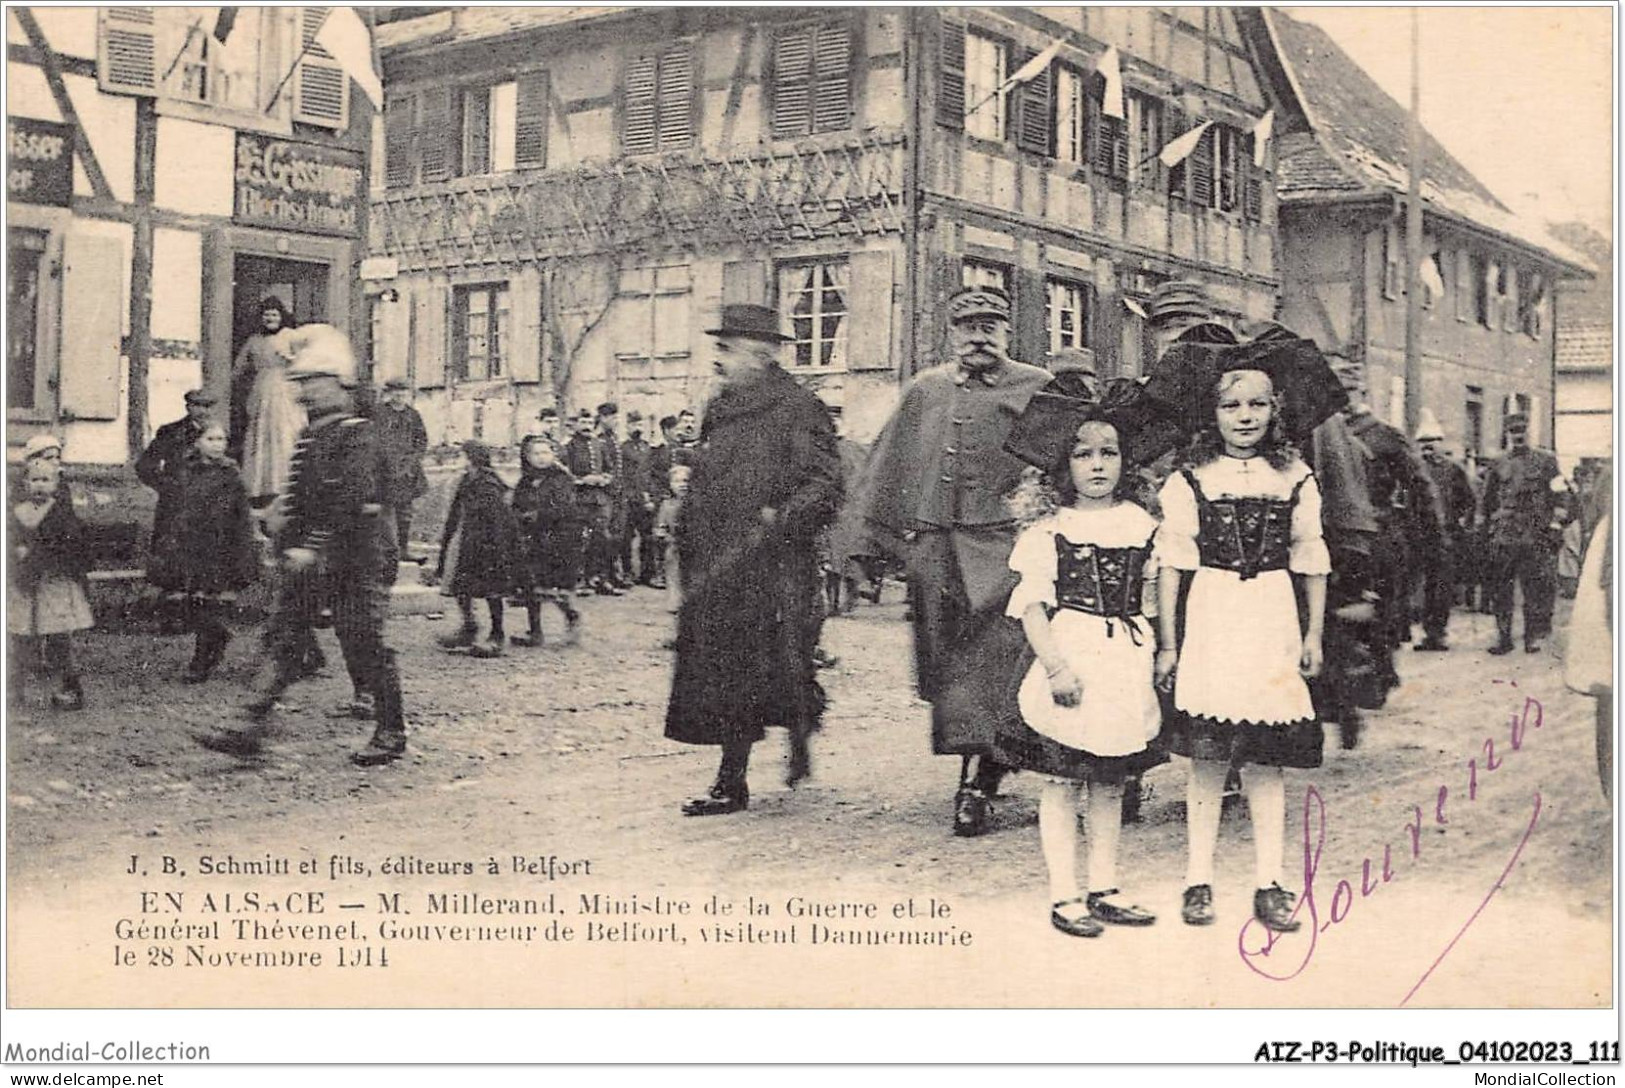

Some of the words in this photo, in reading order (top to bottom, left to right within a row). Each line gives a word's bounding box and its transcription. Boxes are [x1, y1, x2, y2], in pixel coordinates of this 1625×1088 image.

[126, 855, 148, 877] J.
[162, 855, 187, 878] B.
[199, 854, 289, 876] Schmitt
[299, 858, 317, 875] et
[330, 854, 373, 880] fils,
[381, 856, 474, 875] éditeurs
[488, 857, 500, 875] à
[513, 855, 591, 881] Belfort
[140, 891, 184, 913] EN
[200, 891, 326, 914] ALSACE
[377, 891, 411, 914] M.
[578, 893, 692, 916] Ministre
[703, 895, 734, 916] de
[748, 896, 771, 916] la
[786, 897, 878, 918] Guerre
[892, 898, 915, 919] et
[930, 898, 952, 919] le
[114, 918, 219, 940] Général
[378, 919, 538, 942] Gouverneur
[544, 919, 574, 942] de
[587, 920, 688, 945] Belfort,
[699, 921, 797, 944] visitent
[810, 923, 973, 947] Dannemarie
[114, 945, 136, 966] le
[147, 946, 174, 967] 28
[185, 945, 323, 967] Novembre
[336, 946, 389, 968] 1914
